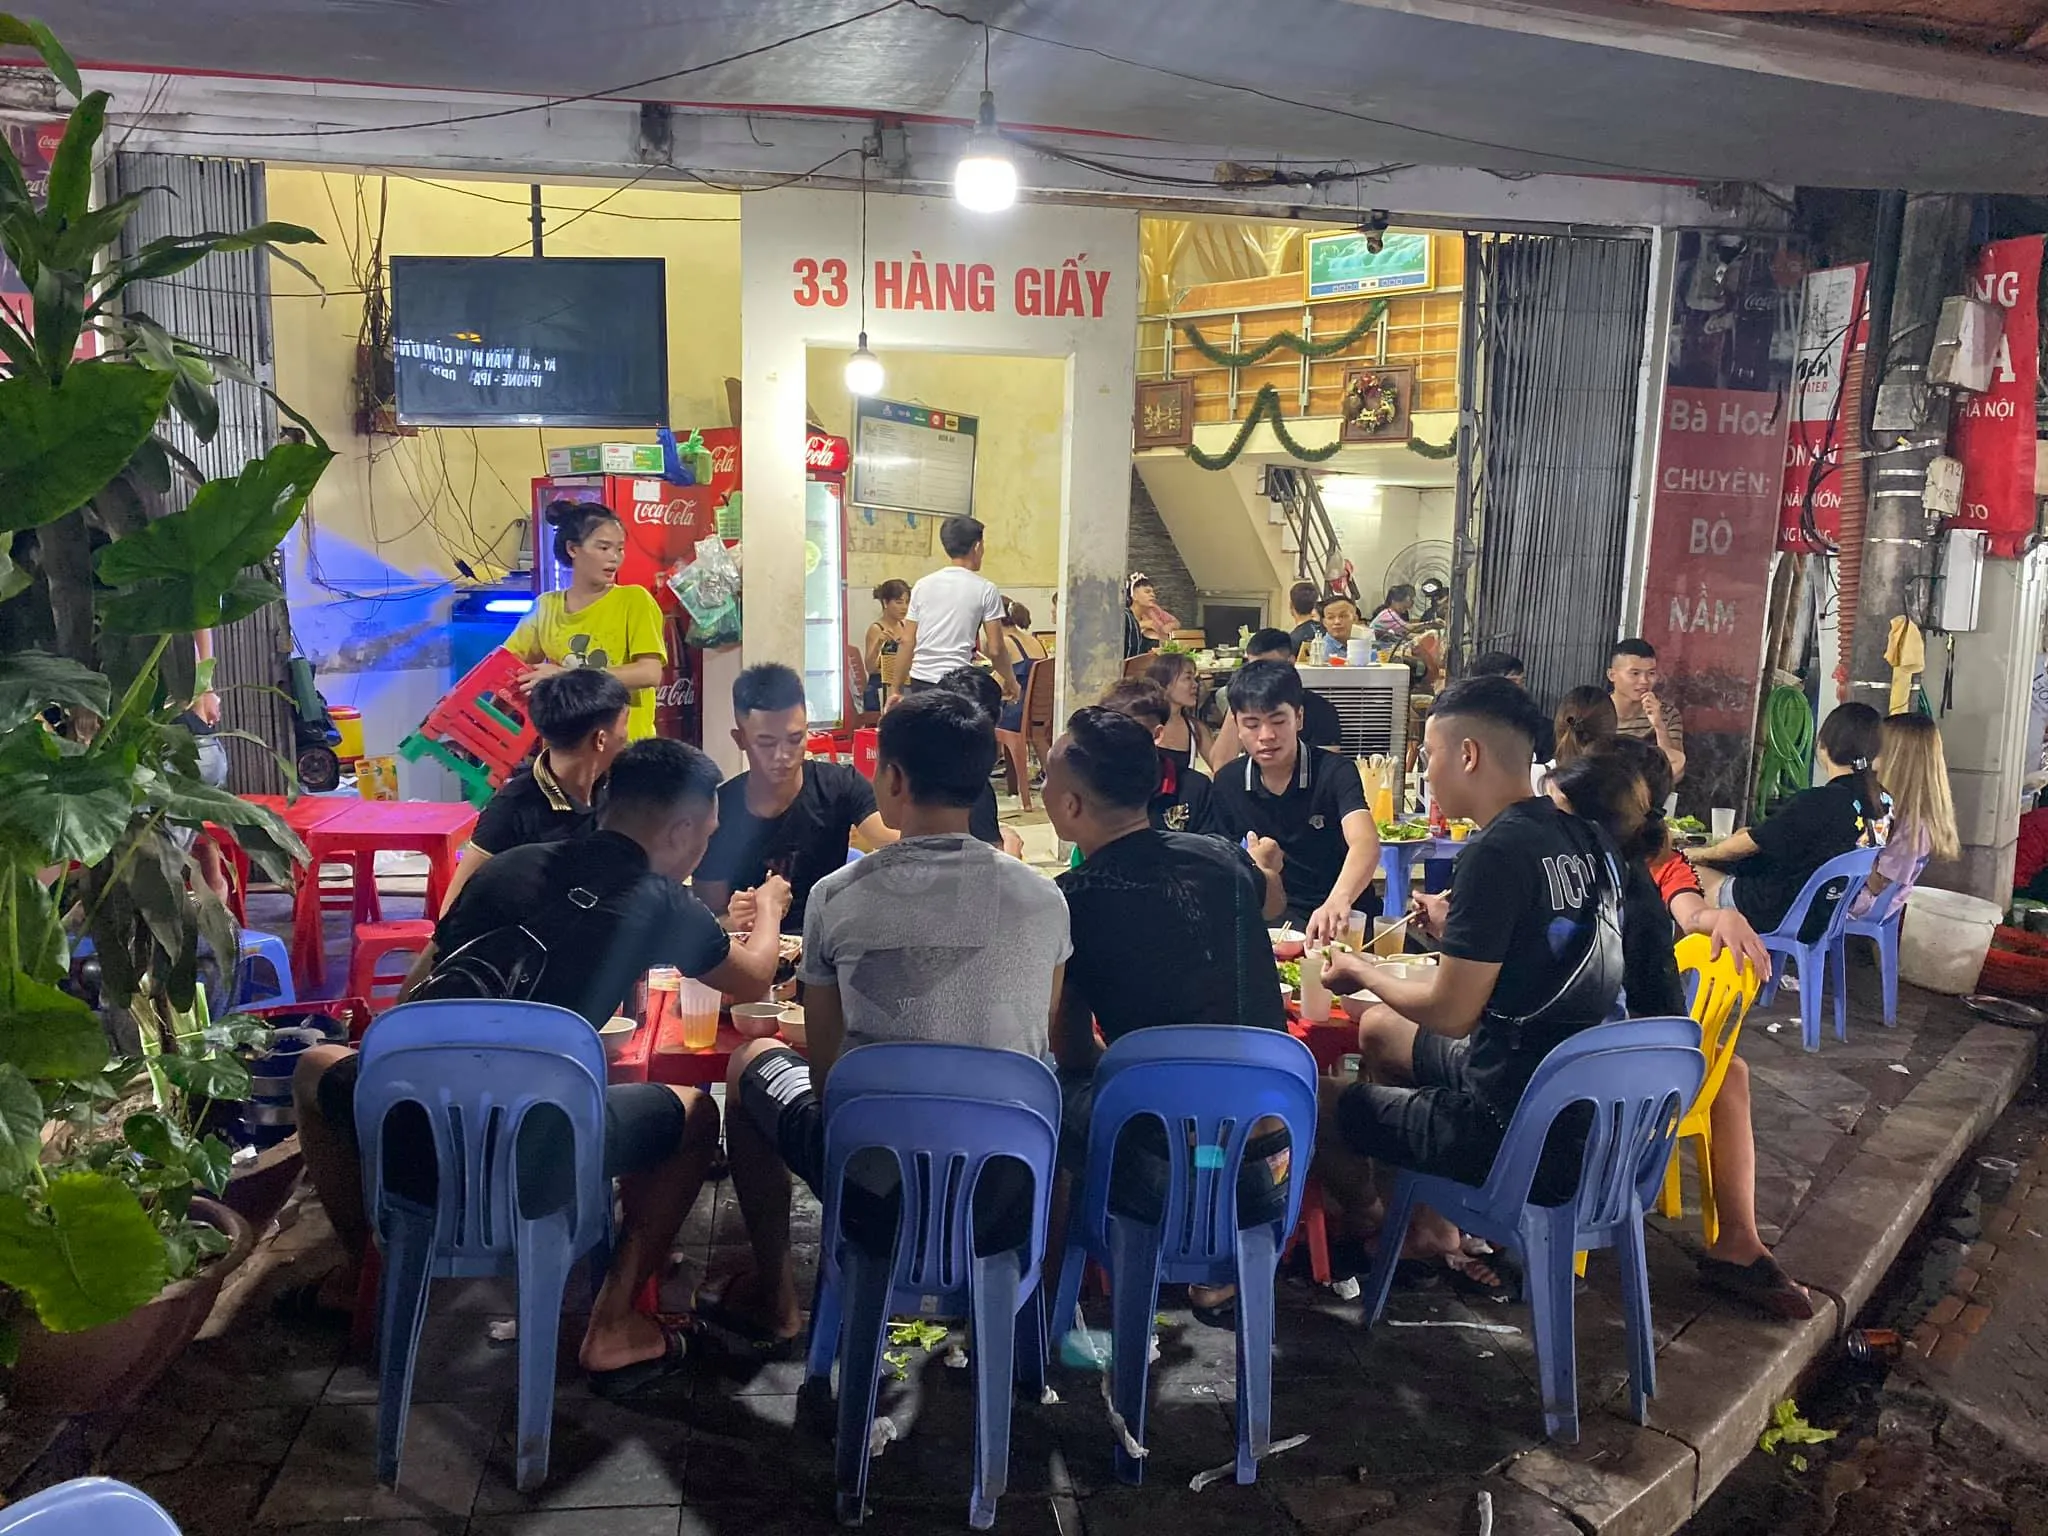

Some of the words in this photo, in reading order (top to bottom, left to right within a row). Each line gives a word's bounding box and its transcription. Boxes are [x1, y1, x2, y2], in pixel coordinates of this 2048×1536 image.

[792, 257, 849, 308] 33
[874, 250, 995, 313] HÀNG
[1014, 252, 1112, 319] GIẤY
[1668, 398, 1708, 433] Bà
[1717, 401, 1777, 437] Hoa
[1984, 398, 2015, 422] NỘI
[634, 498, 697, 526] Coca-Cola
[1689, 511, 1734, 556] BÒ
